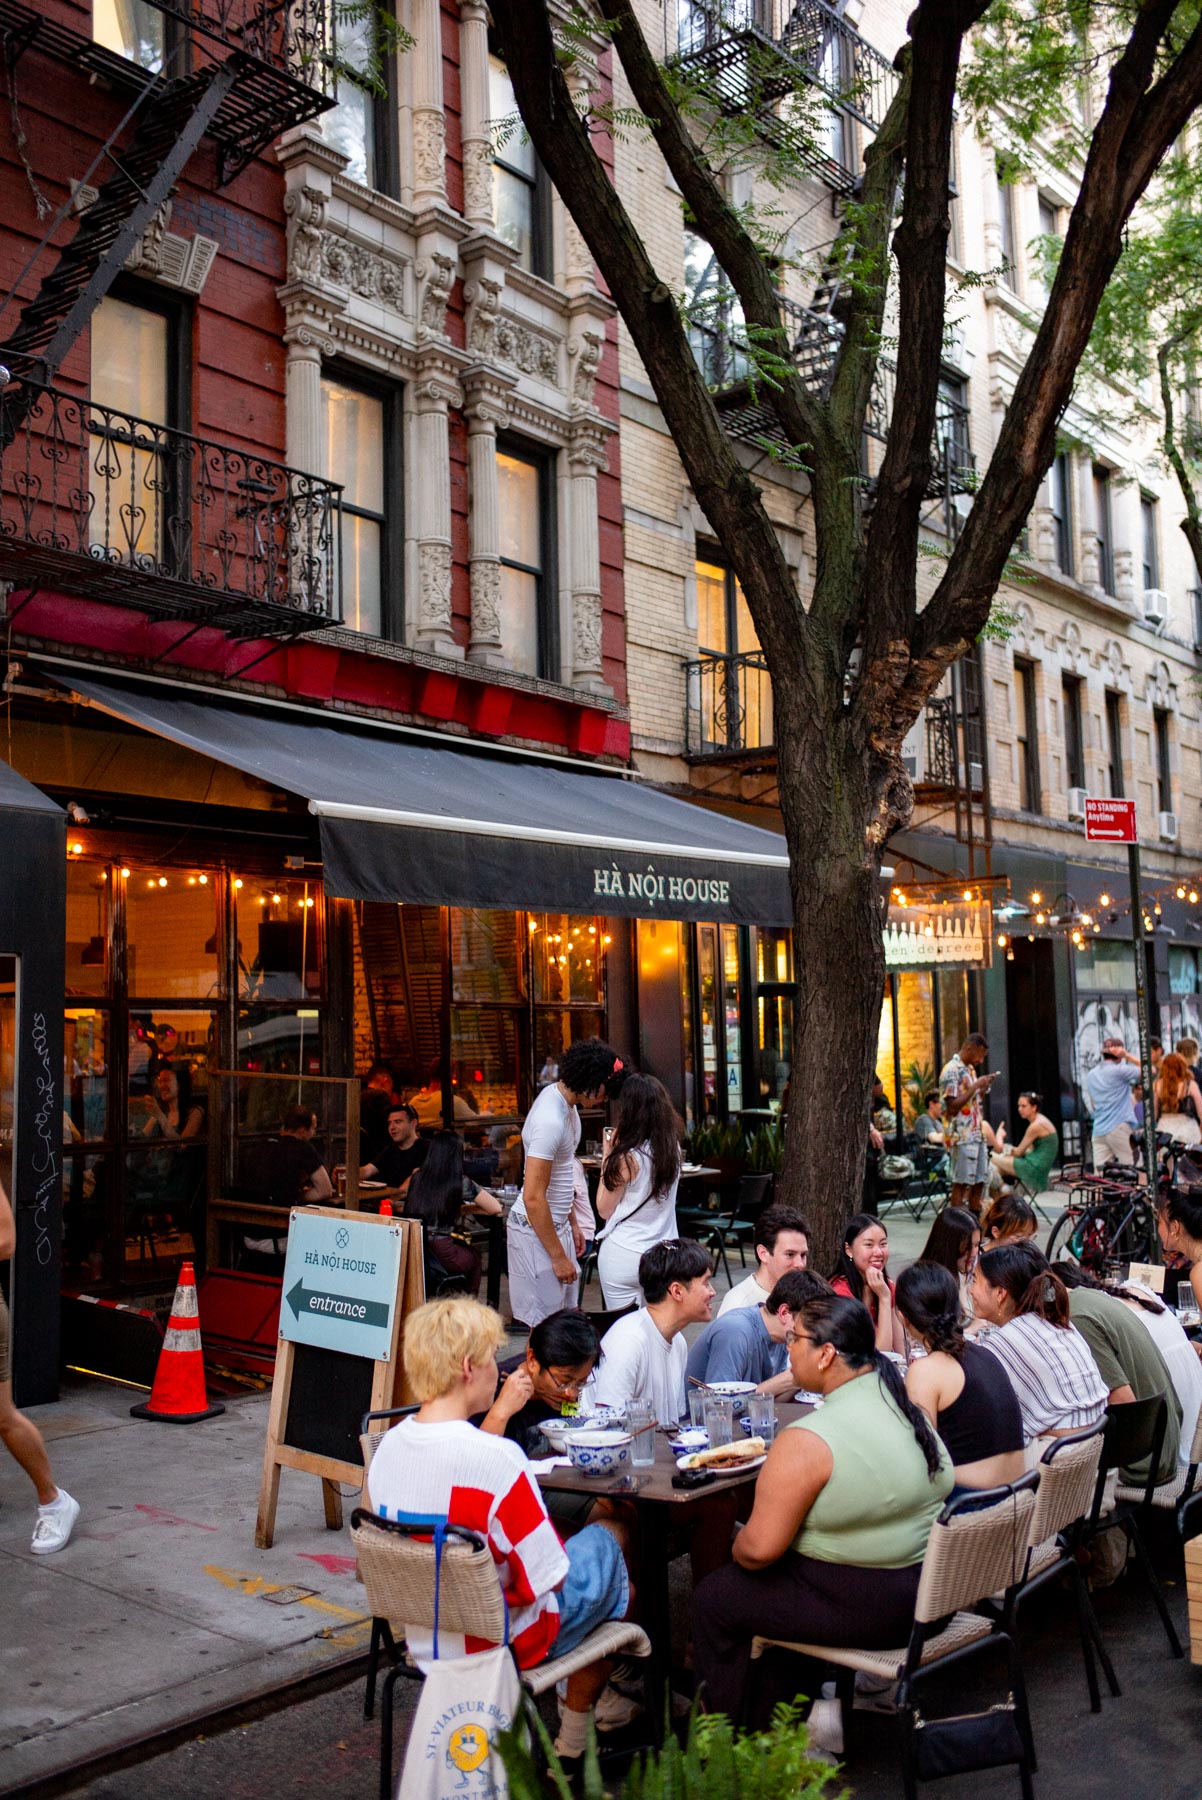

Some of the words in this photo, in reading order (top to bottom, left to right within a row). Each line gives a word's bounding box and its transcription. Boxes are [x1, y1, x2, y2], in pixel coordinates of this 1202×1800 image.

[1087, 801, 1097, 811] NO
[1097, 802, 1129, 812] STANDING
[1087, 812, 1114, 822] Anytime
[593, 862, 625, 896] HÀ
[628, 865, 665, 907] NỘI
[668, 876, 731, 904] HOUSE
[727, 1068, 738, 1086] A
[304, 1249, 318, 1265] HÀ
[321, 1251, 341, 1272] NỘI
[342, 1258, 376, 1274] HOUSE
[309, 1295, 367, 1319] entrance
